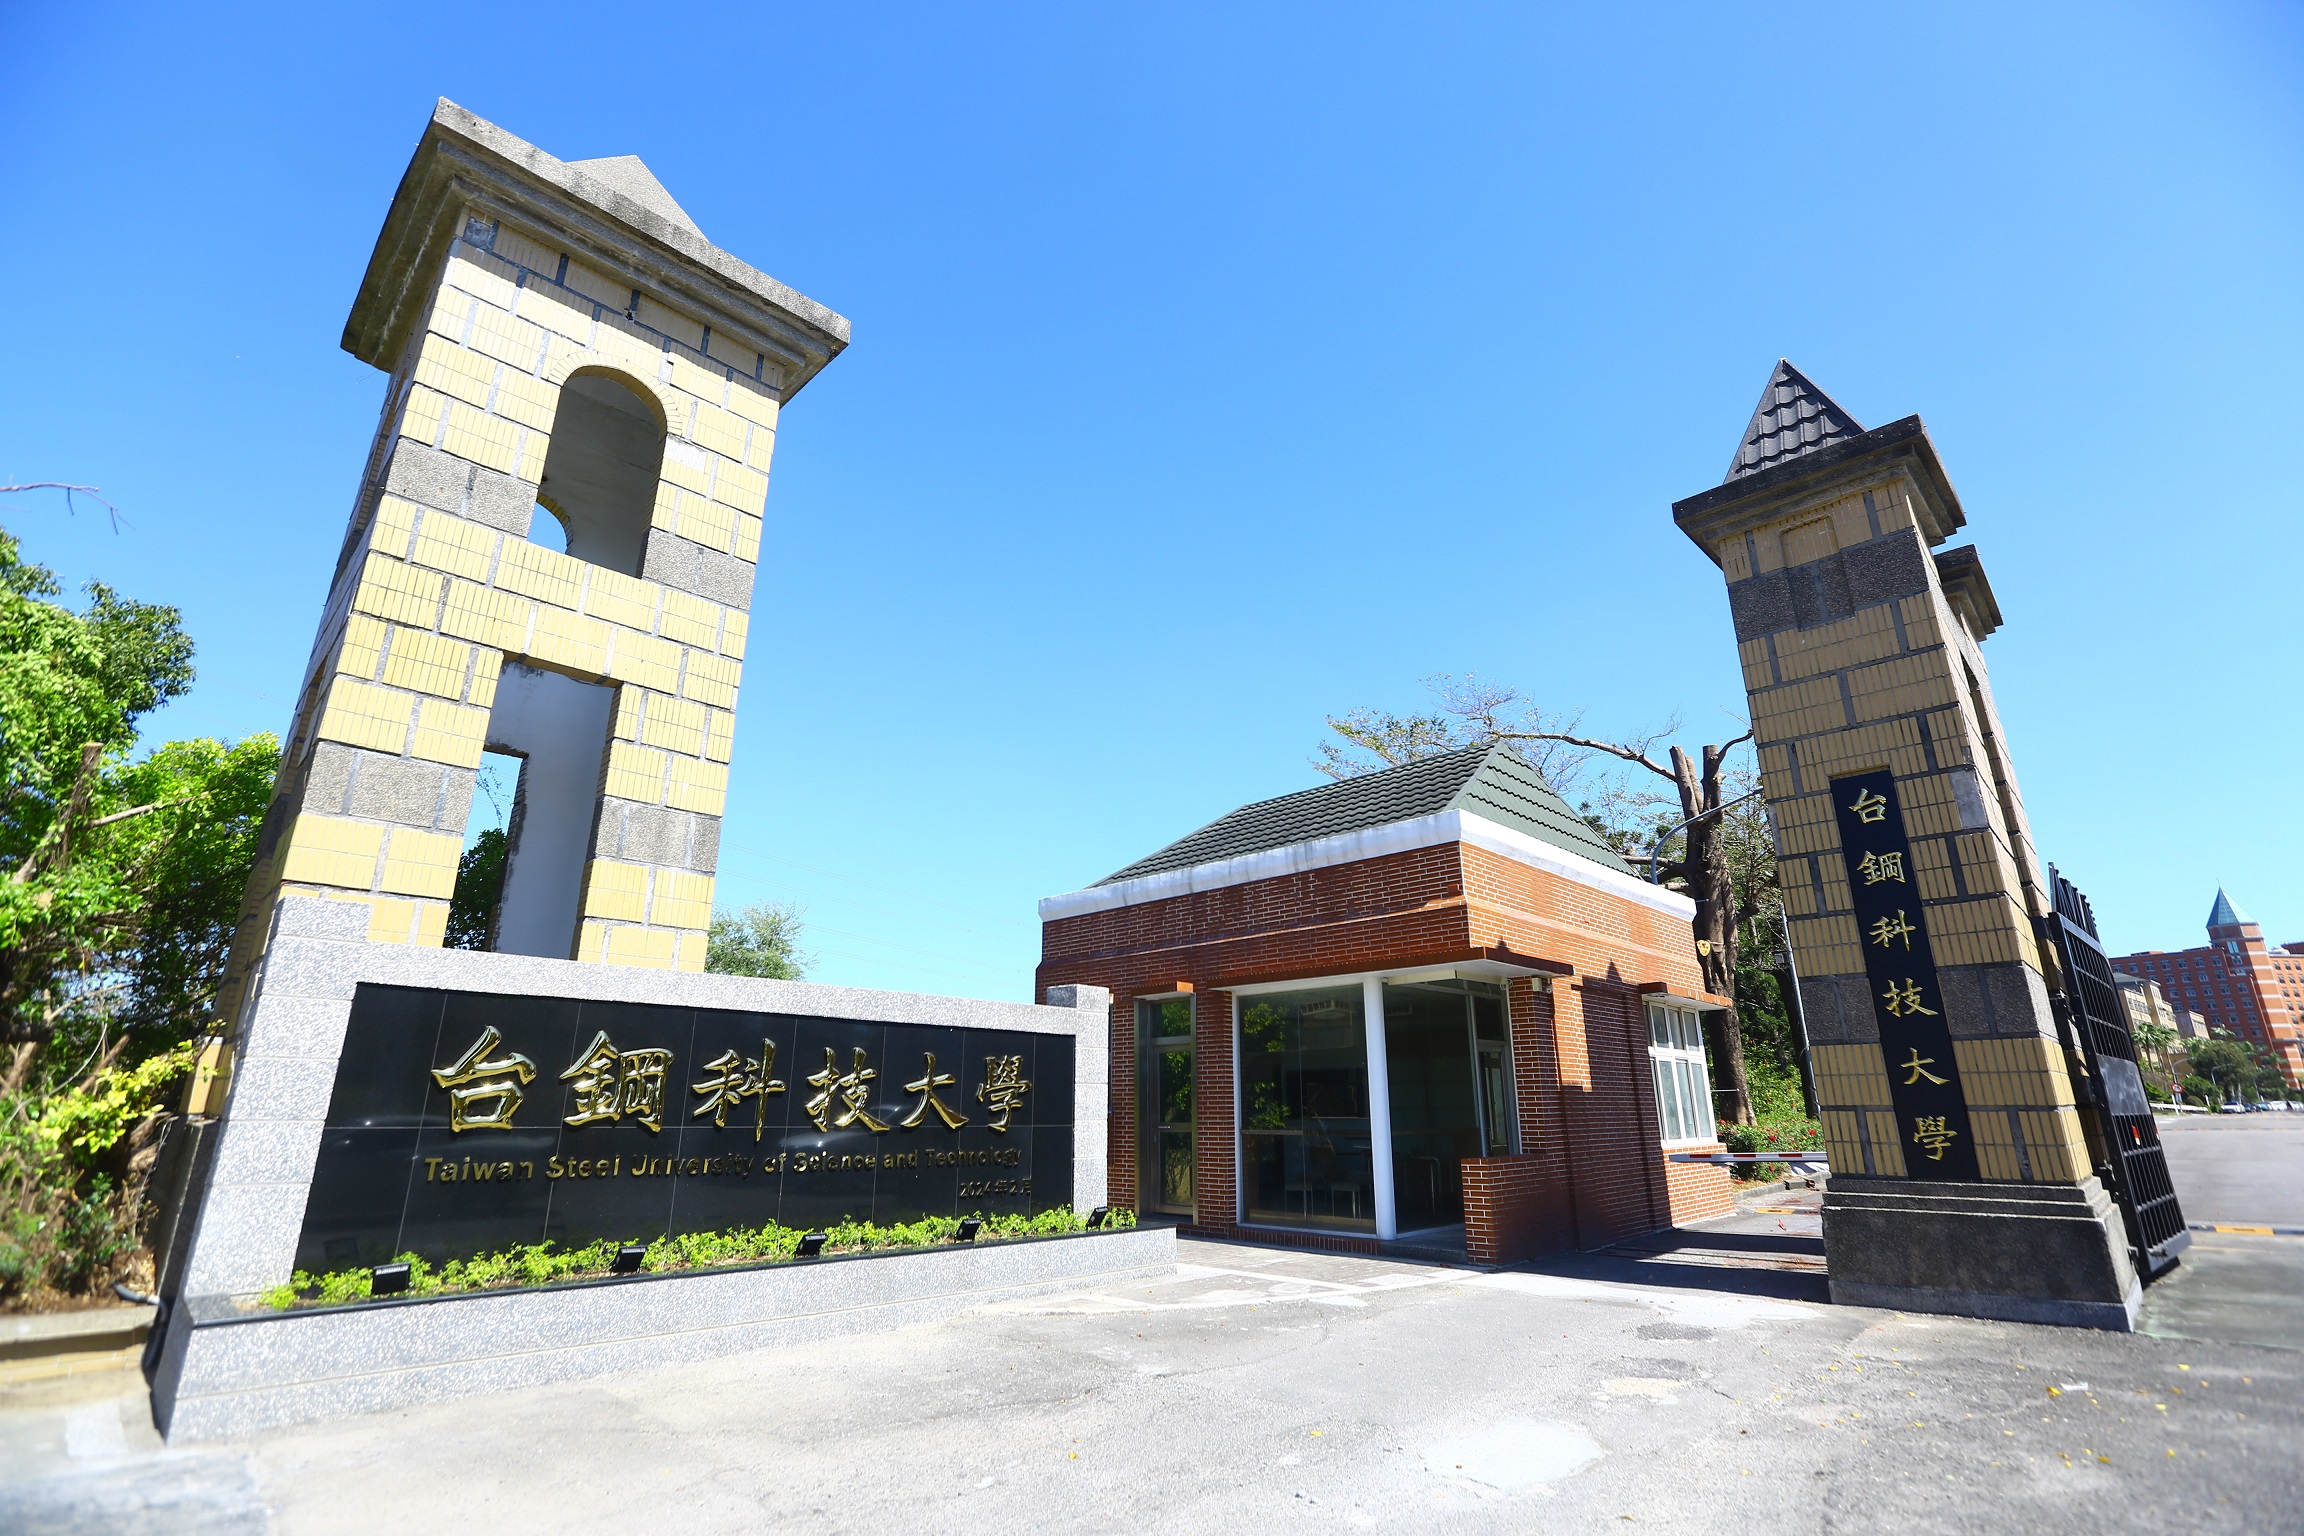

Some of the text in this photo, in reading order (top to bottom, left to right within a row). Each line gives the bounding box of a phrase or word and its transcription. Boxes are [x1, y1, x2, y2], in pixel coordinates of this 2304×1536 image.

[1848, 787, 1958, 1161] 台鋼科技大學
[430, 1025, 1033, 1142] 台鋼科技大學
[424, 1147, 1022, 1182] Taiwan Steel University of Science and Technology
